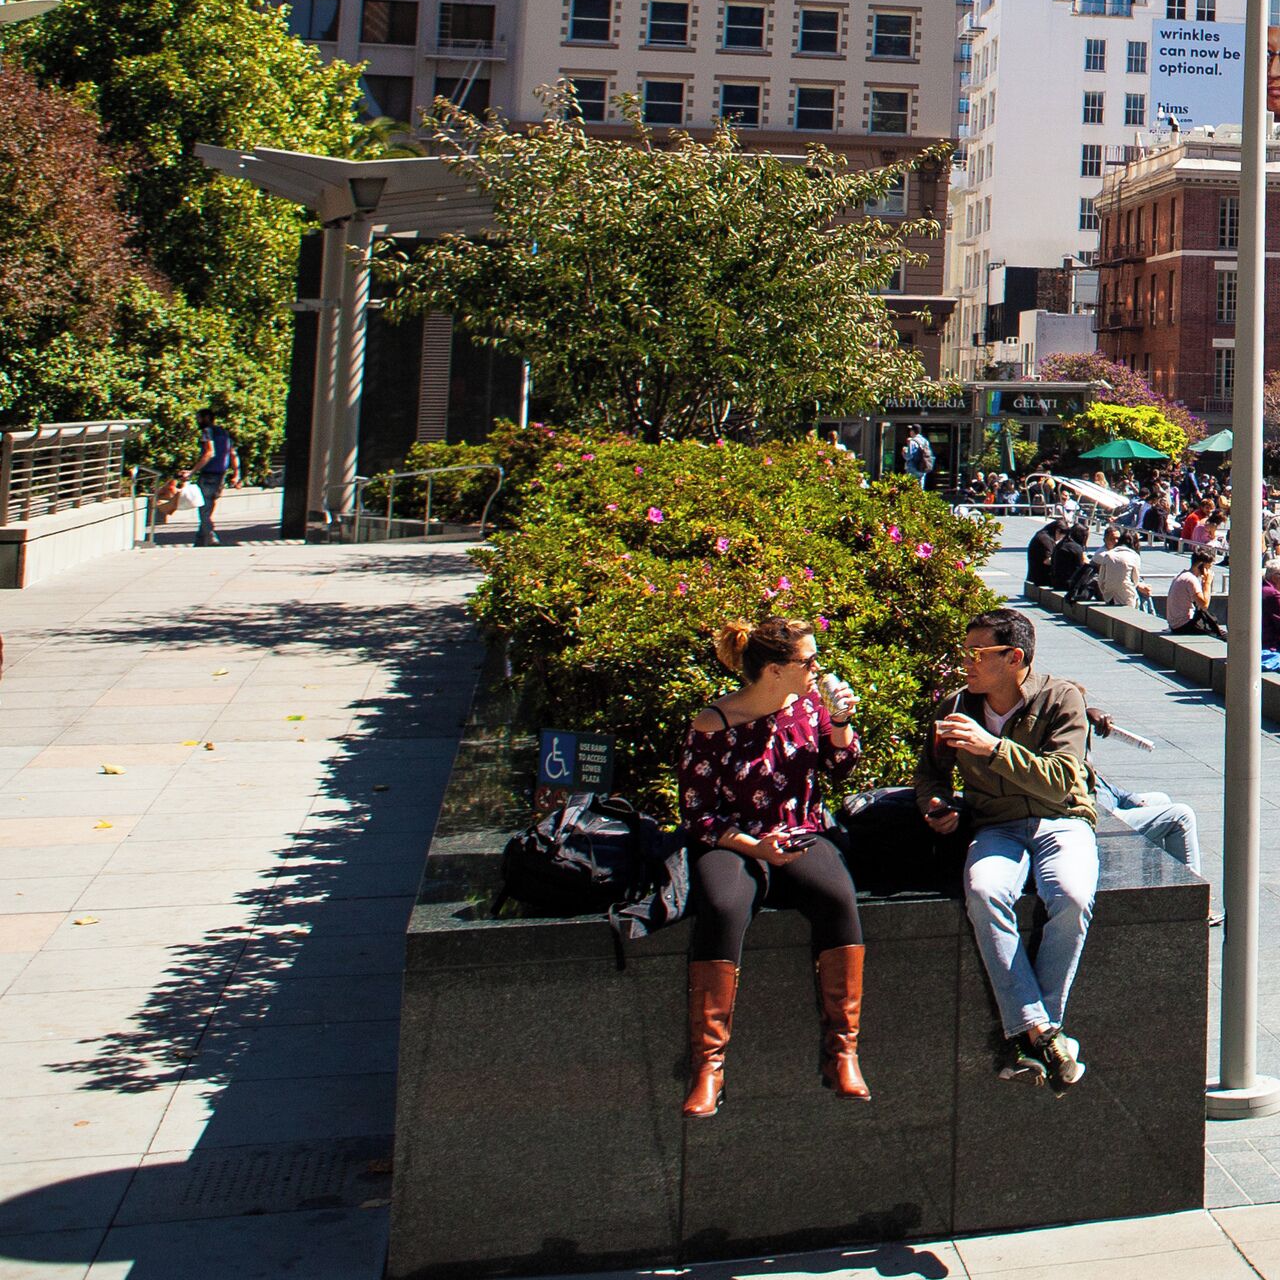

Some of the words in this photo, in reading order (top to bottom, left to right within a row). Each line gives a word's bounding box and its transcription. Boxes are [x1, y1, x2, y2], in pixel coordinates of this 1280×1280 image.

[1160, 27, 1220, 42] wrinkles
[1159, 47, 1186, 57] can
[1190, 48, 1220, 58] now
[1223, 47, 1241, 60] be
[1159, 61, 1222, 76] optional.
[885, 397, 966, 409] PASTICCERIA
[1013, 396, 1057, 409] GELATI
[580, 742, 591, 751] USE
[578, 752, 587, 761] TO
[587, 754, 607, 763] ACCESS
[582, 764, 602, 773] LOWER
[582, 774, 600, 783] PLAZA
